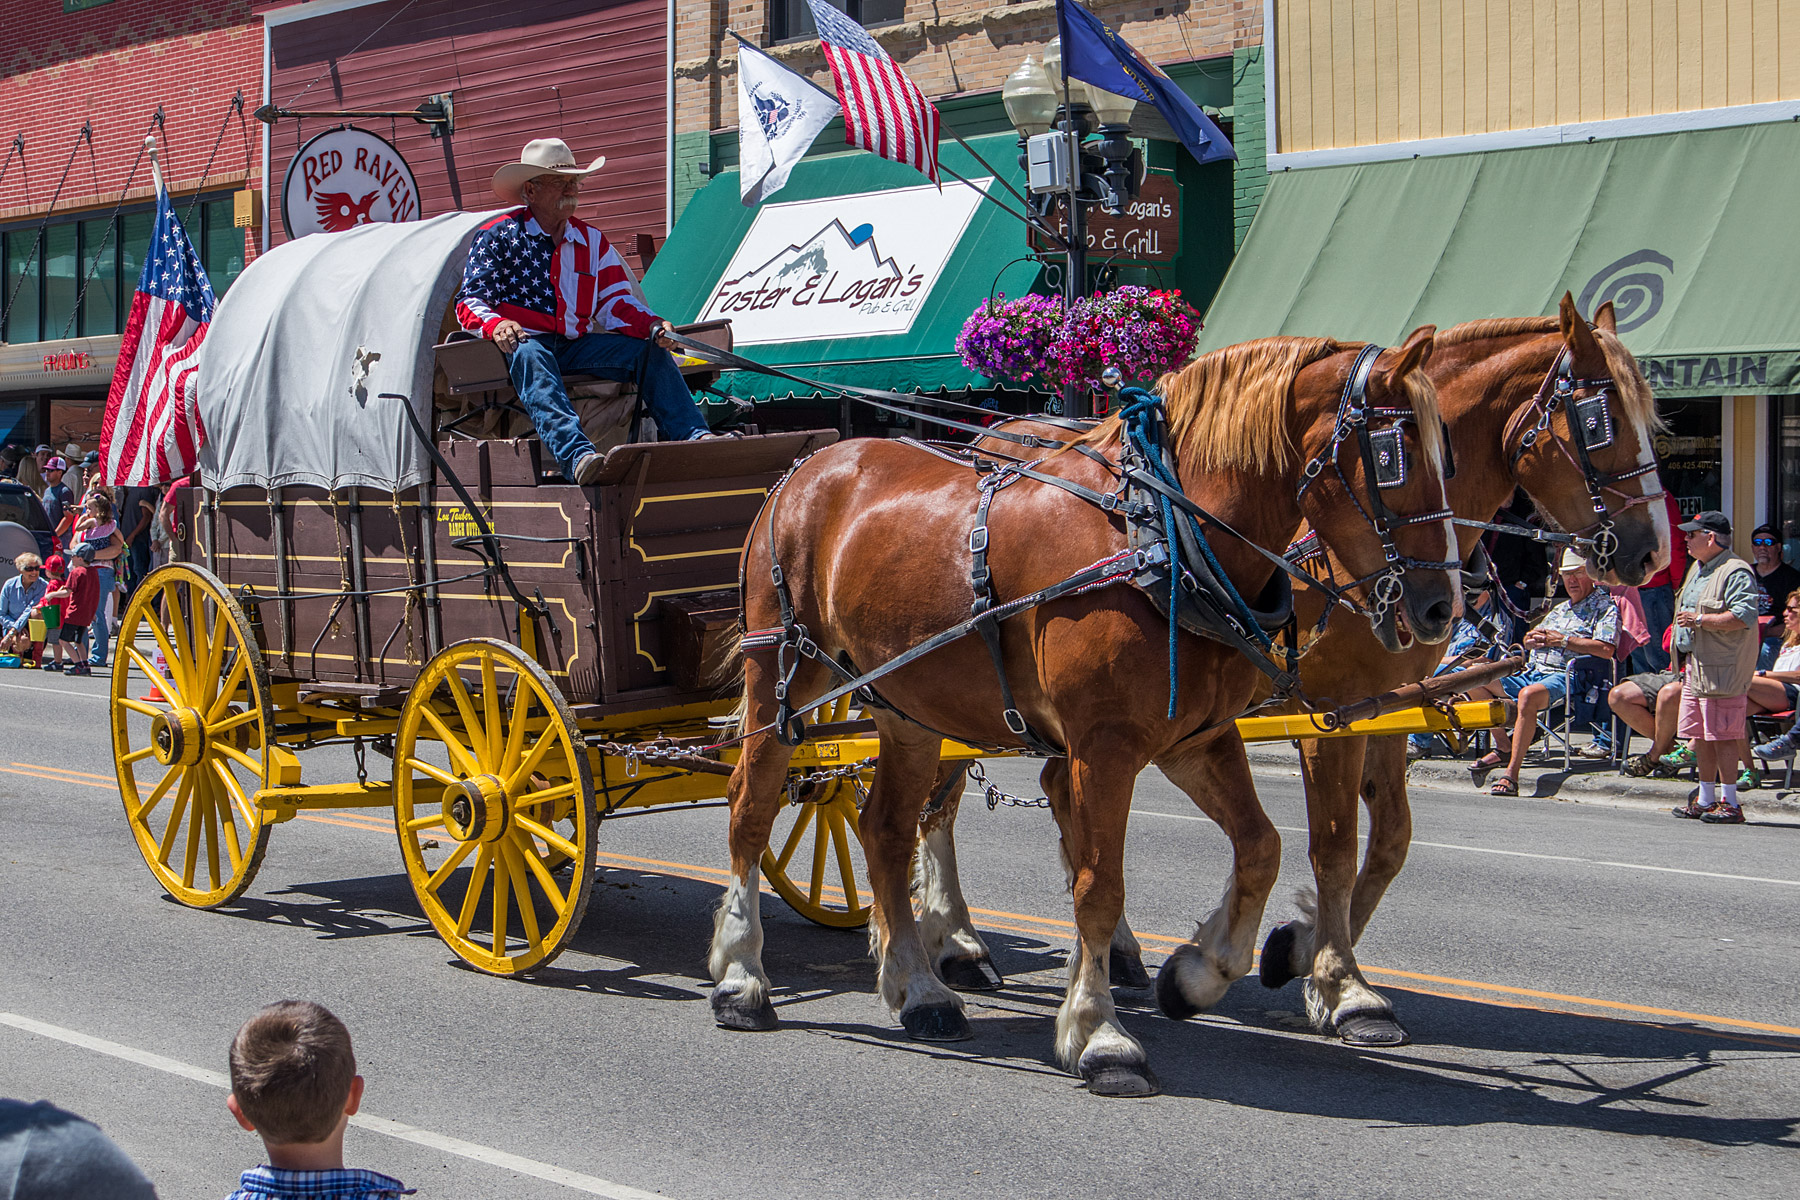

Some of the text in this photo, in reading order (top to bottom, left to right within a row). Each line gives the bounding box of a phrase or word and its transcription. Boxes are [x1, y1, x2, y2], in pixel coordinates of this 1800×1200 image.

[302, 147, 415, 223] RED RAVEN
[1101, 228, 1117, 250] &
[1122, 228, 1162, 260] Grill
[702, 264, 925, 322] Foster & Logan's
[858, 298, 918, 315] Pub & Grill
[1638, 356, 1768, 388] NTAIN
